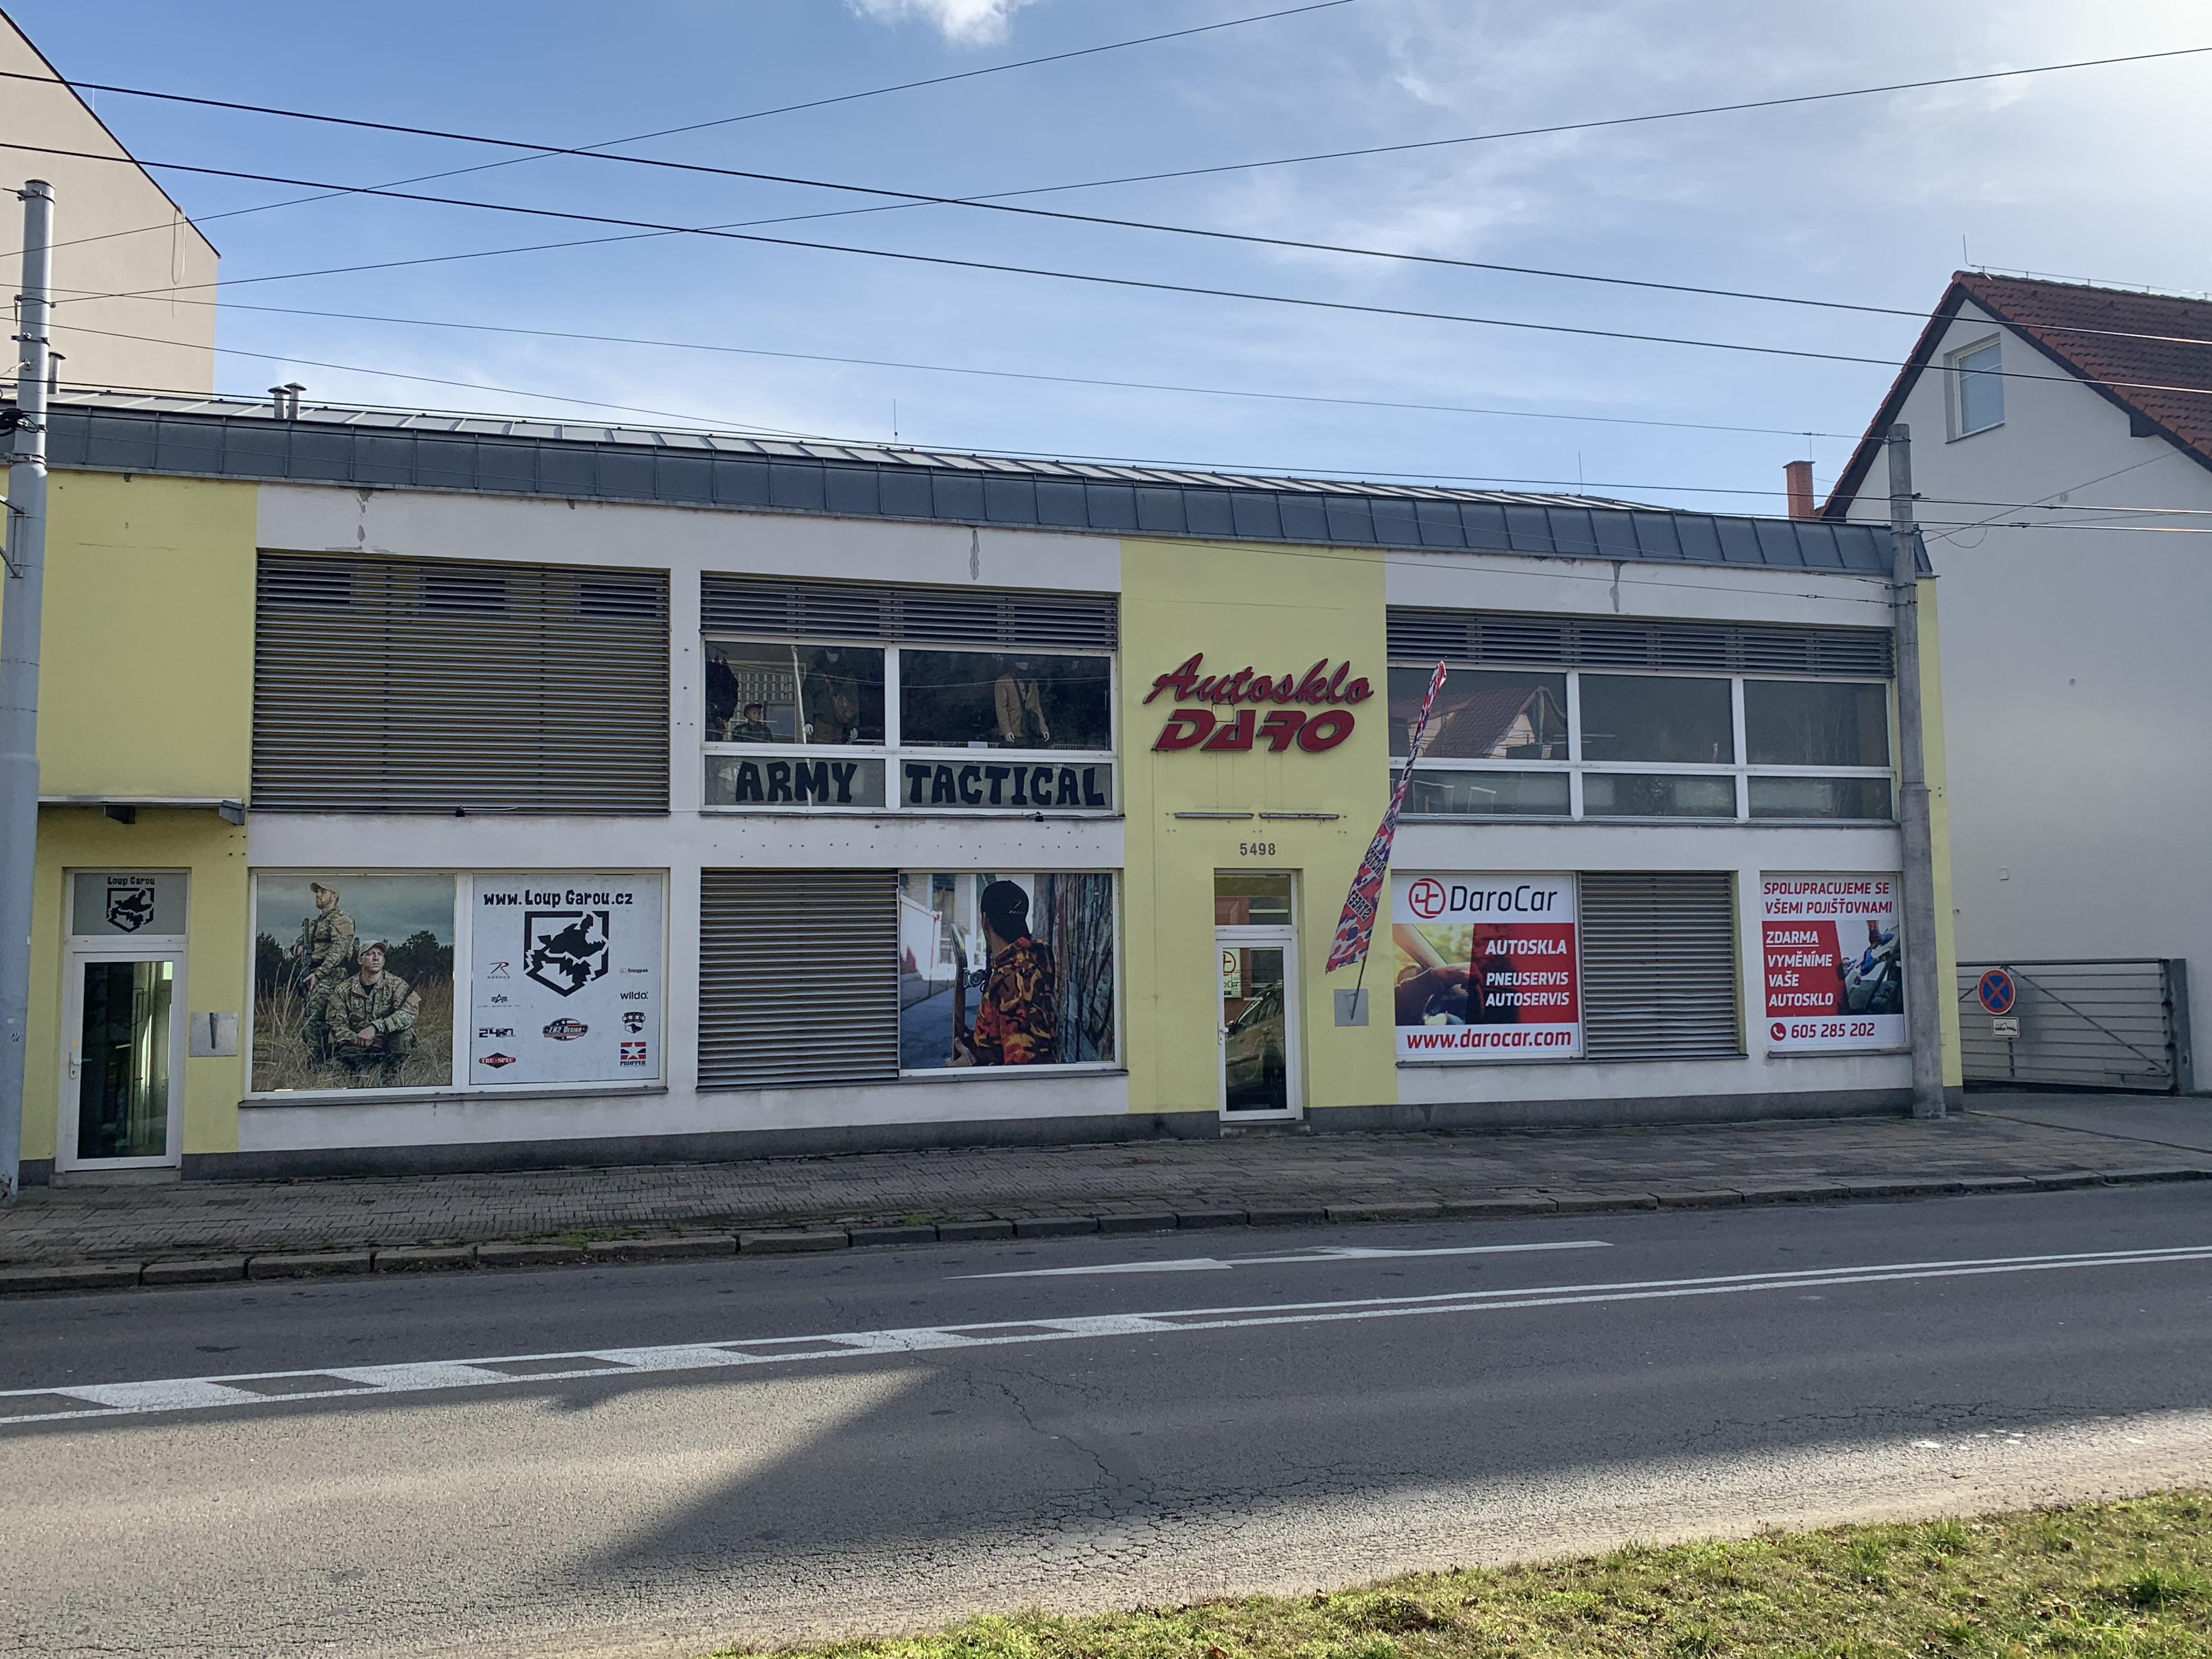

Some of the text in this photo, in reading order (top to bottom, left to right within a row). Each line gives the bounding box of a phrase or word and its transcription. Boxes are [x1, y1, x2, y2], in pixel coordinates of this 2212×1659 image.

[1142, 653, 1374, 705] Autosklo
[1152, 709, 1355, 752] DARO
[736, 761, 1105, 806] ARMY TACTICAL
[1239, 842, 1276, 857] 5498
[107, 876, 155, 886] Loup Garou
[1764, 882, 1889, 895] SPOLUPRACUJEME SE
[565, 889, 633, 905] Garou.cz
[1449, 885, 1558, 912] DaroCar
[1765, 898, 1892, 914] VŠEMI POJIŠŤOVNAMI
[1766, 931, 1819, 943] ZDARMA
[1485, 940, 1567, 955] AUTOSKLA
[1767, 951, 1833, 967] VYMĚNÍME
[1486, 972, 1569, 986] PNEUSERVIS
[1768, 971, 1799, 987] VAŠE
[1485, 992, 1569, 1006] AUTOSERVIS
[1769, 993, 1834, 1007] AUTOSKLO
[1791, 1022, 1875, 1039] 605 285 202
[1407, 1029, 1572, 1049] www.darocar.com
